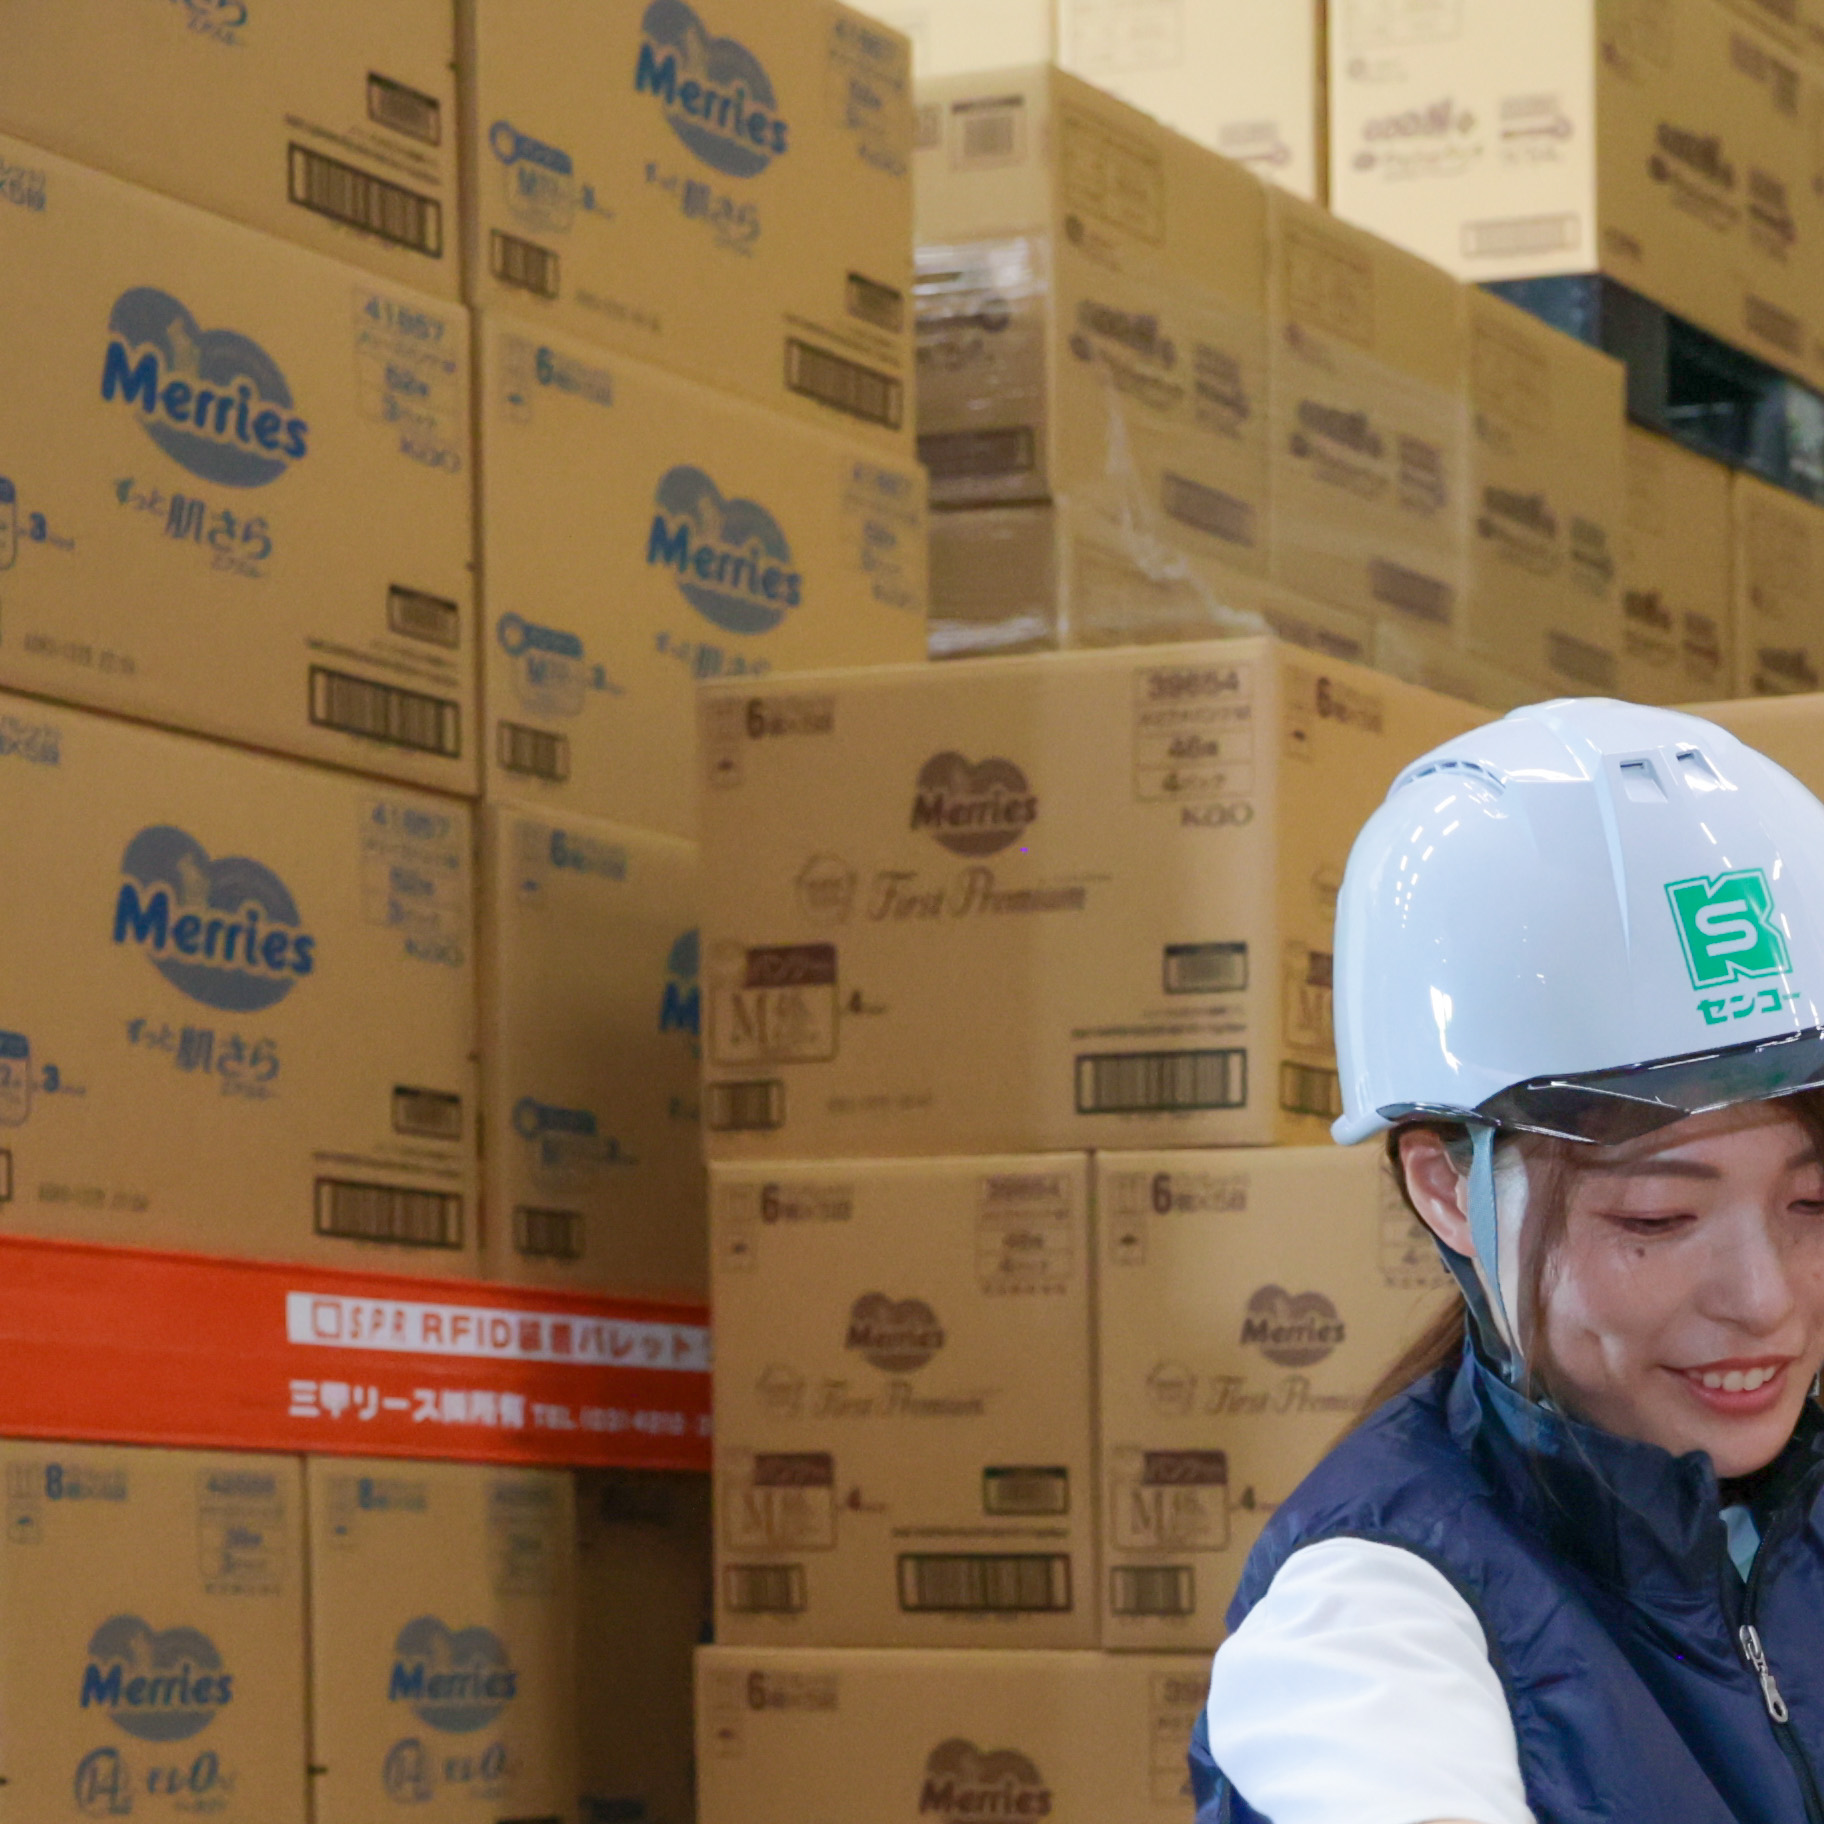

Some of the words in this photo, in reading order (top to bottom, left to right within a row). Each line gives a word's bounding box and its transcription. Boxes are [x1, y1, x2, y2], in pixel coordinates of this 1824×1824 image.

[634, 41, 789, 156] Merries
[102, 341, 309, 461] Merries
[647, 514, 801, 607] Merries
[909, 788, 1037, 832] Merries
[113, 883, 316, 977] Merries
[1697, 988, 1801, 1025] センコー
[846, 1320, 947, 1352] Merries
[1241, 1316, 1346, 1346] Merries
[81, 1661, 233, 1708] Merries
[389, 1661, 518, 1702] Merries
[918, 1780, 1051, 1819] Merries
